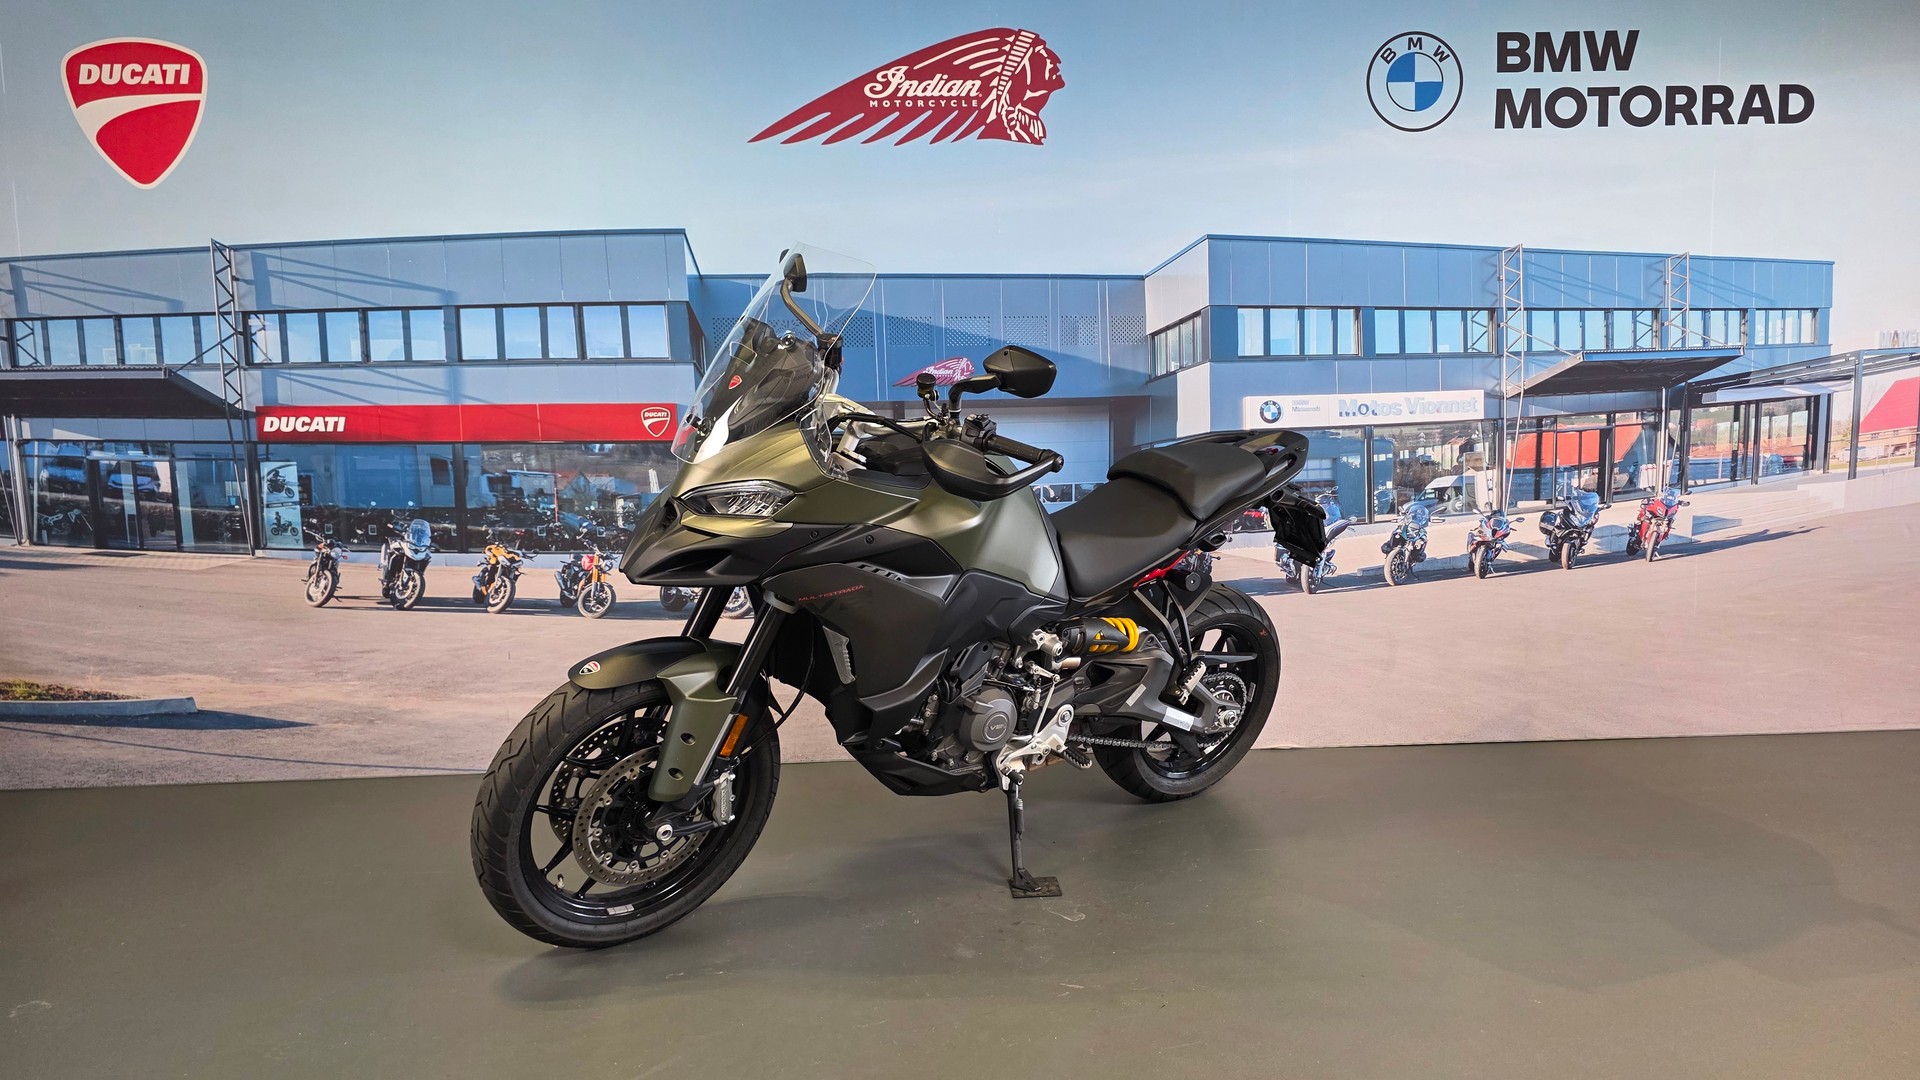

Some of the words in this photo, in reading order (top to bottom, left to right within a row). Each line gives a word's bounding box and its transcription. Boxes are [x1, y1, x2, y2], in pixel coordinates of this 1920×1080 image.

[1380, 37, 1450, 65] BMW
[1496, 30, 1640, 73] BMW
[78, 63, 191, 85] DUCATI
[863, 66, 982, 99] Indian
[869, 99, 979, 108] MOTORCYCLE
[1494, 84, 1815, 129] MOTORRAD
[1339, 399, 1403, 417] Motos
[1404, 396, 1478, 415] Vionnet
[263, 416, 346, 433] DUCATI
